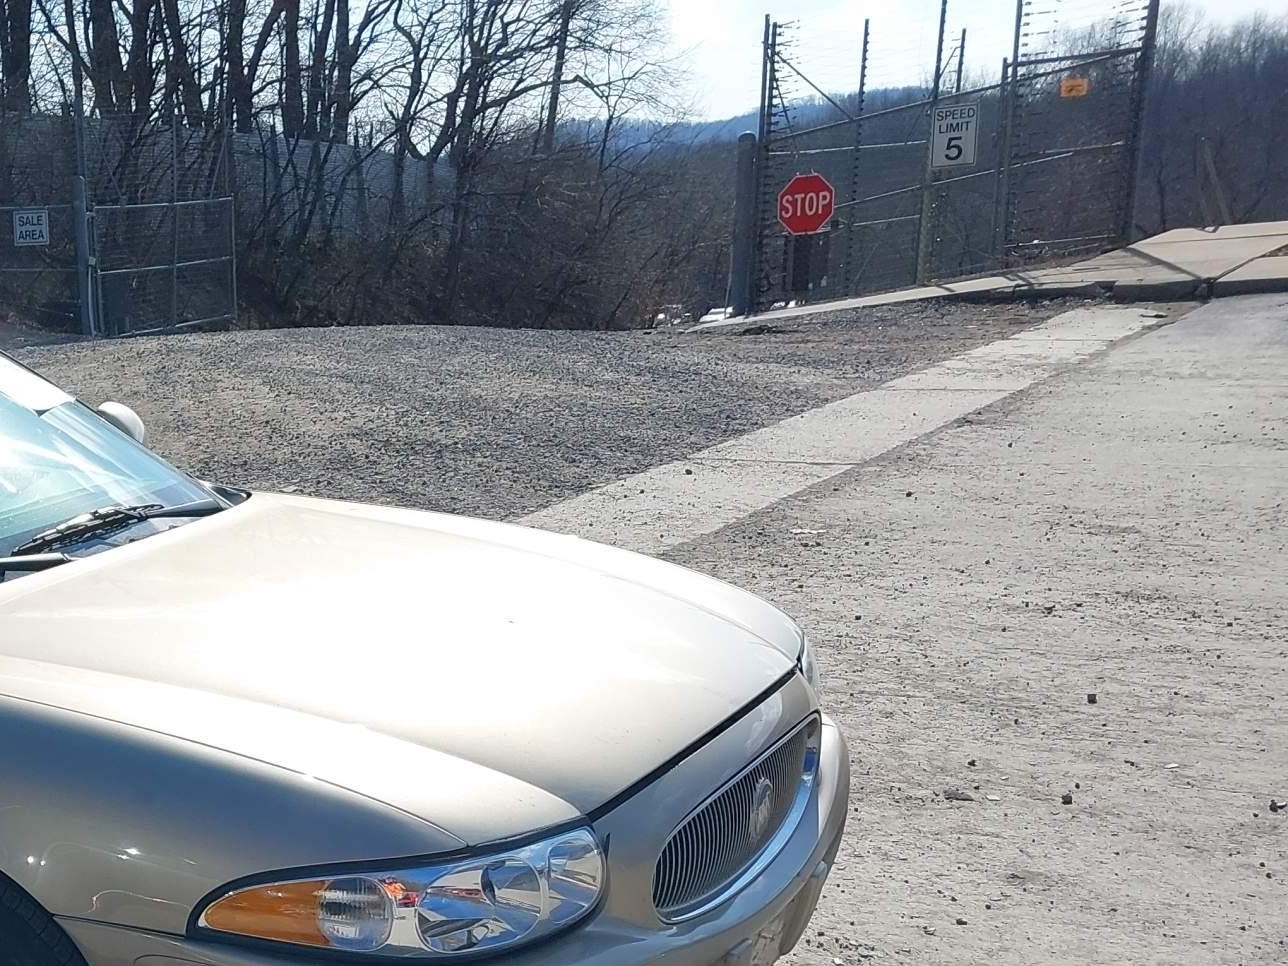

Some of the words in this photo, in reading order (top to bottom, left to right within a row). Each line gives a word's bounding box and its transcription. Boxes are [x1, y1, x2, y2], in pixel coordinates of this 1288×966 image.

[936, 107, 976, 121] SPEED
[938, 120, 972, 134] LIMIT
[944, 136, 963, 161] 5
[781, 190, 831, 218] STOP
[18, 215, 44, 226] SALE
[18, 230, 45, 241] AREA
